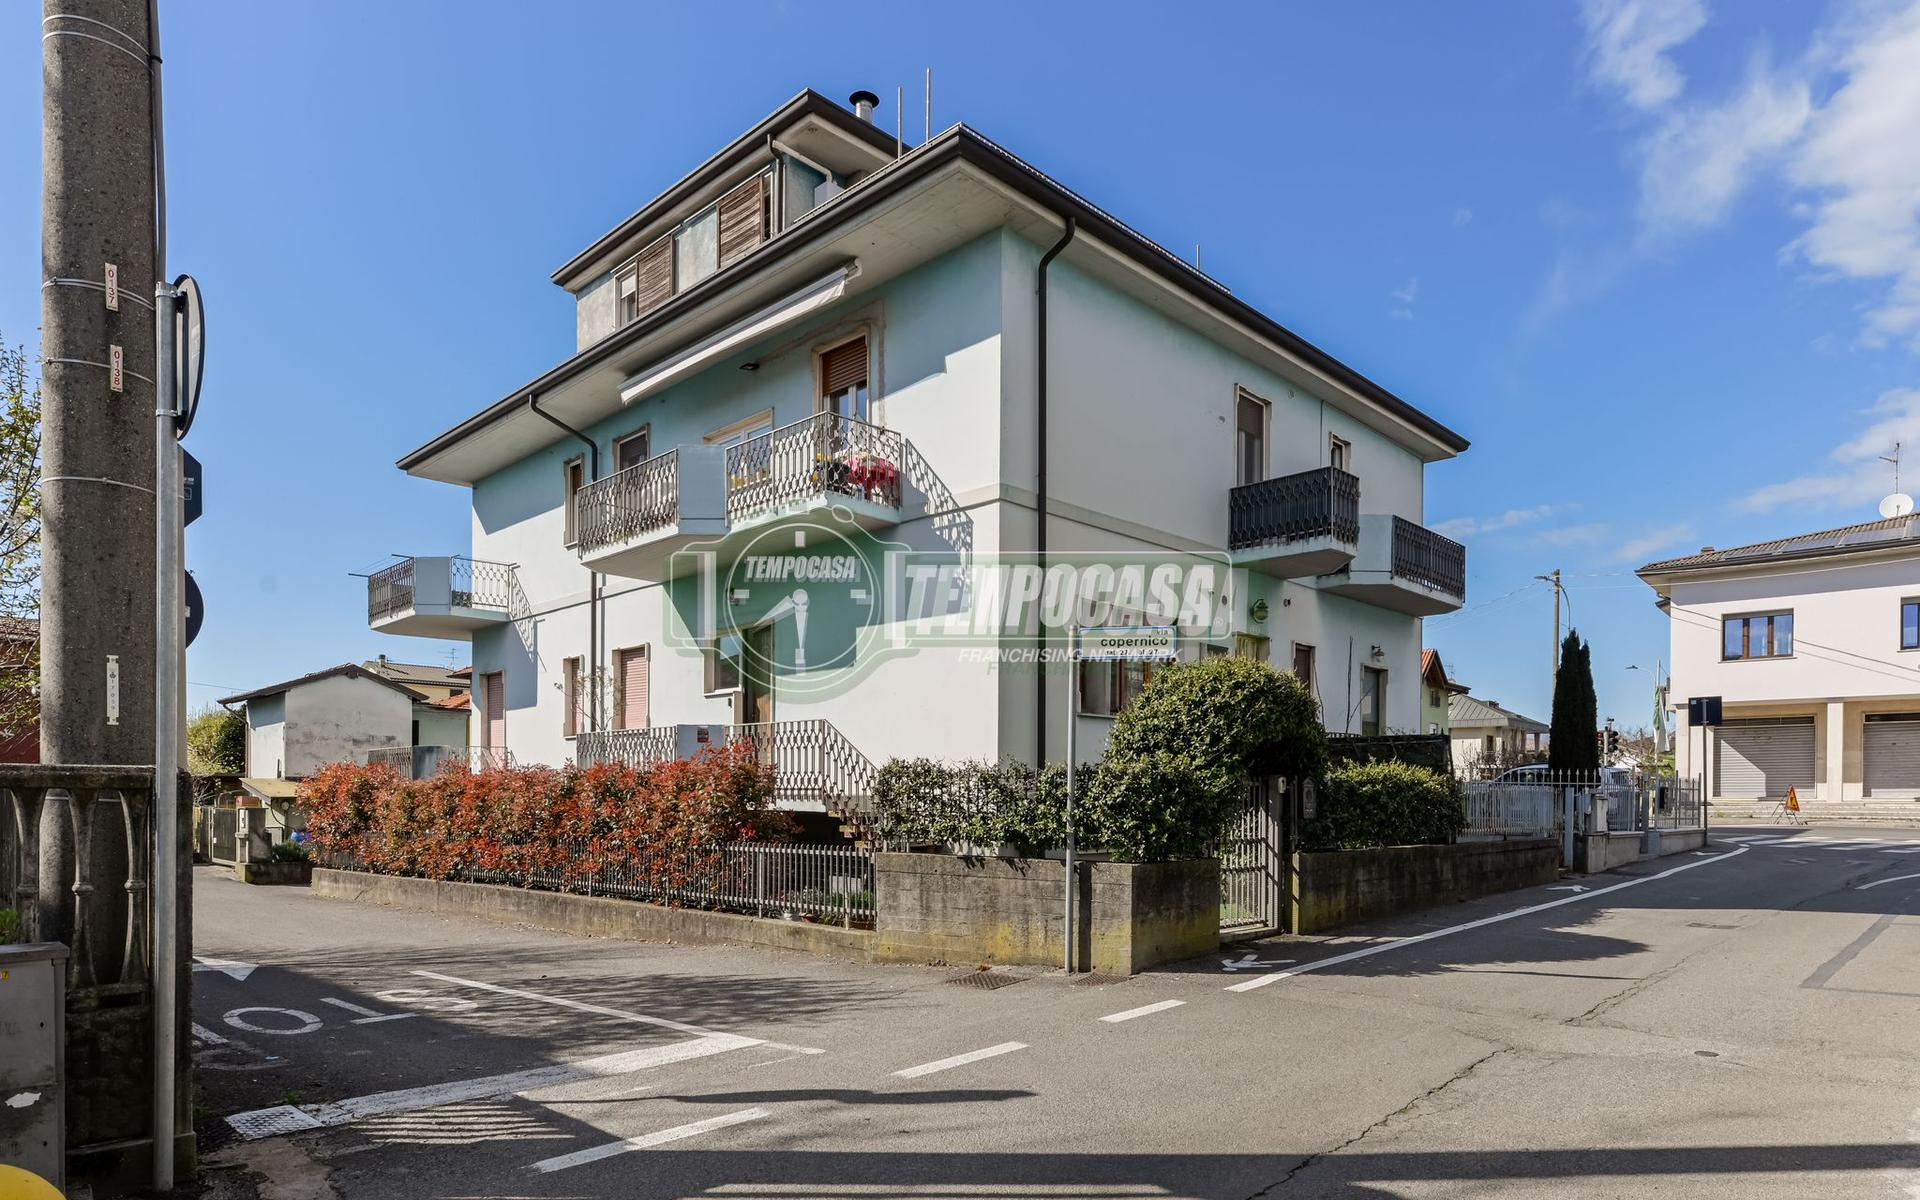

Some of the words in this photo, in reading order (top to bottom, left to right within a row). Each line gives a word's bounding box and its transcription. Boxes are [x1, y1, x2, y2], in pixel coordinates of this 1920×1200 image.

[107, 269, 116, 304] 0137
[113, 350, 121, 386] 0138
[1100, 635, 1168, 648] copernico
